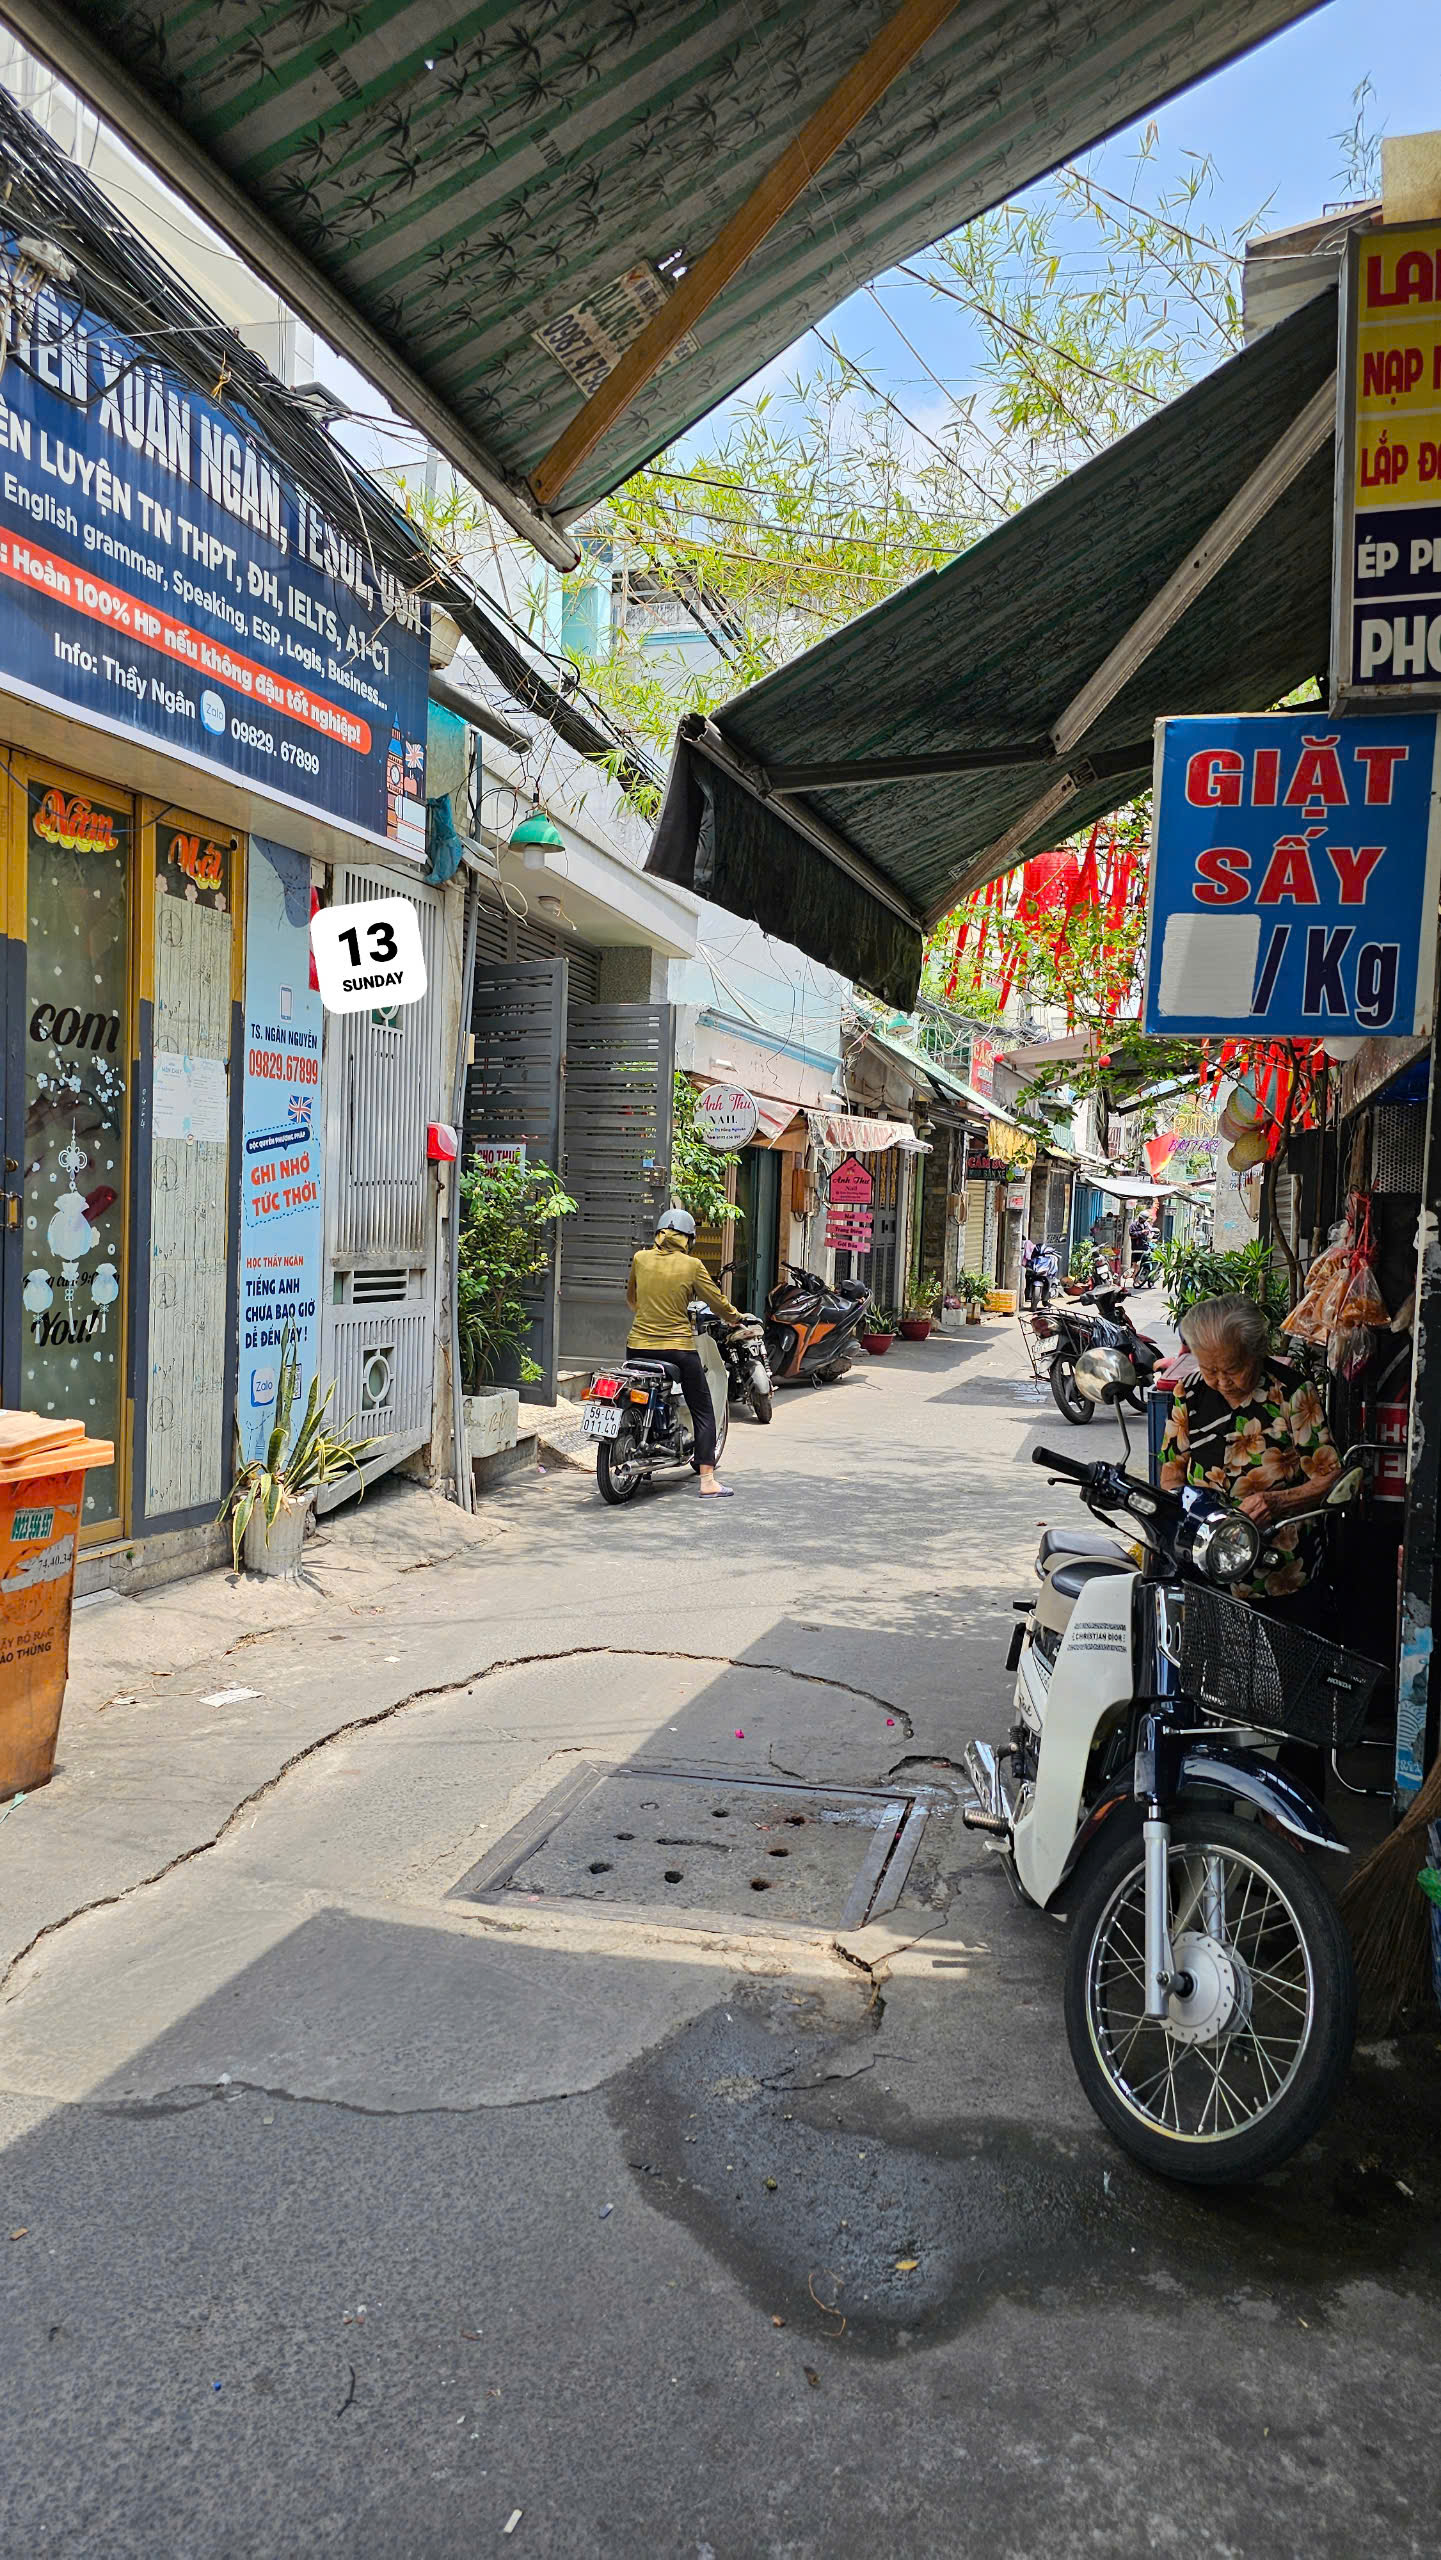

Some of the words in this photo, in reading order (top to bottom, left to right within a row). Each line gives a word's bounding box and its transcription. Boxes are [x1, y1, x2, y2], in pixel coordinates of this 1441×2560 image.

[1367, 248, 1441, 308] LA
[1363, 347, 1424, 405] NẠP
[1361, 429, 1409, 487] LẮP
[40, 429, 131, 521] LUYỆN
[137, 490, 171, 544] TN
[177, 515, 242, 594] THPT,
[247, 560, 284, 617] ĐH,
[288, 585, 342, 652] IELTS,
[1357, 535, 1400, 579] ÉP
[4, 471, 78, 537] English
[83, 523, 169, 592] grammar,
[173, 569, 248, 637] Speaking,
[252, 615, 283, 656] ESP,
[286, 634, 325, 679] Logis,
[12, 544, 71, 596] Hoàn
[74, 577, 131, 625] 100%
[134, 607, 161, 638] HP
[164, 629, 198, 660] nếu
[201, 641, 252, 692] không
[255, 673, 284, 704] đậu
[286, 689, 308, 717] tốt
[311, 704, 361, 744] nghiệp!
[54, 632, 98, 675] Info:
[102, 655, 148, 700] Thầy
[151, 678, 196, 719] Ngân
[205, 702, 224, 720] Zalo
[280, 740, 320, 775] 67899
[1185, 735, 1409, 819] GIẶT
[1192, 826, 1387, 906] SẤY
[251, 1023, 263, 1040] TS.
[265, 1025, 286, 1043] NGÂN
[288, 1029, 318, 1050] NGUYỄN
[249, 1048, 318, 1085] 09829.67899
[702, 1094, 724, 1112] Anh
[251, 1162, 276, 1185] GHI
[280, 1150, 310, 1179] NHỚ
[832, 1176, 851, 1185] Anh
[252, 1190, 280, 1217] TỨC
[283, 1180, 317, 1210] THỜI
[246, 1258, 261, 1271] HỌC
[283, 1255, 304, 1267] NGÂN
[245, 1274, 276, 1297] TIẾNG
[278, 1277, 300, 1294] ANH
[31, 1308, 100, 1347] You!
[245, 1302, 273, 1323] CHƯA
[275, 1303, 296, 1320] BAO
[298, 1298, 316, 1318] GIỜ
[245, 1325, 258, 1349] DỄ
[261, 1323, 281, 1346] ĐẾN
[255, 1379, 273, 1393] Zalo
[589, 1406, 615, 1422] 59-C4
[16, 1640, 53, 1659] THÙNG
[1075, 1632, 1107, 1640] CHRISTIAN
[1108, 1633, 1122, 1642] DIOR
[1326, 1676, 1352, 1690] HONDA
